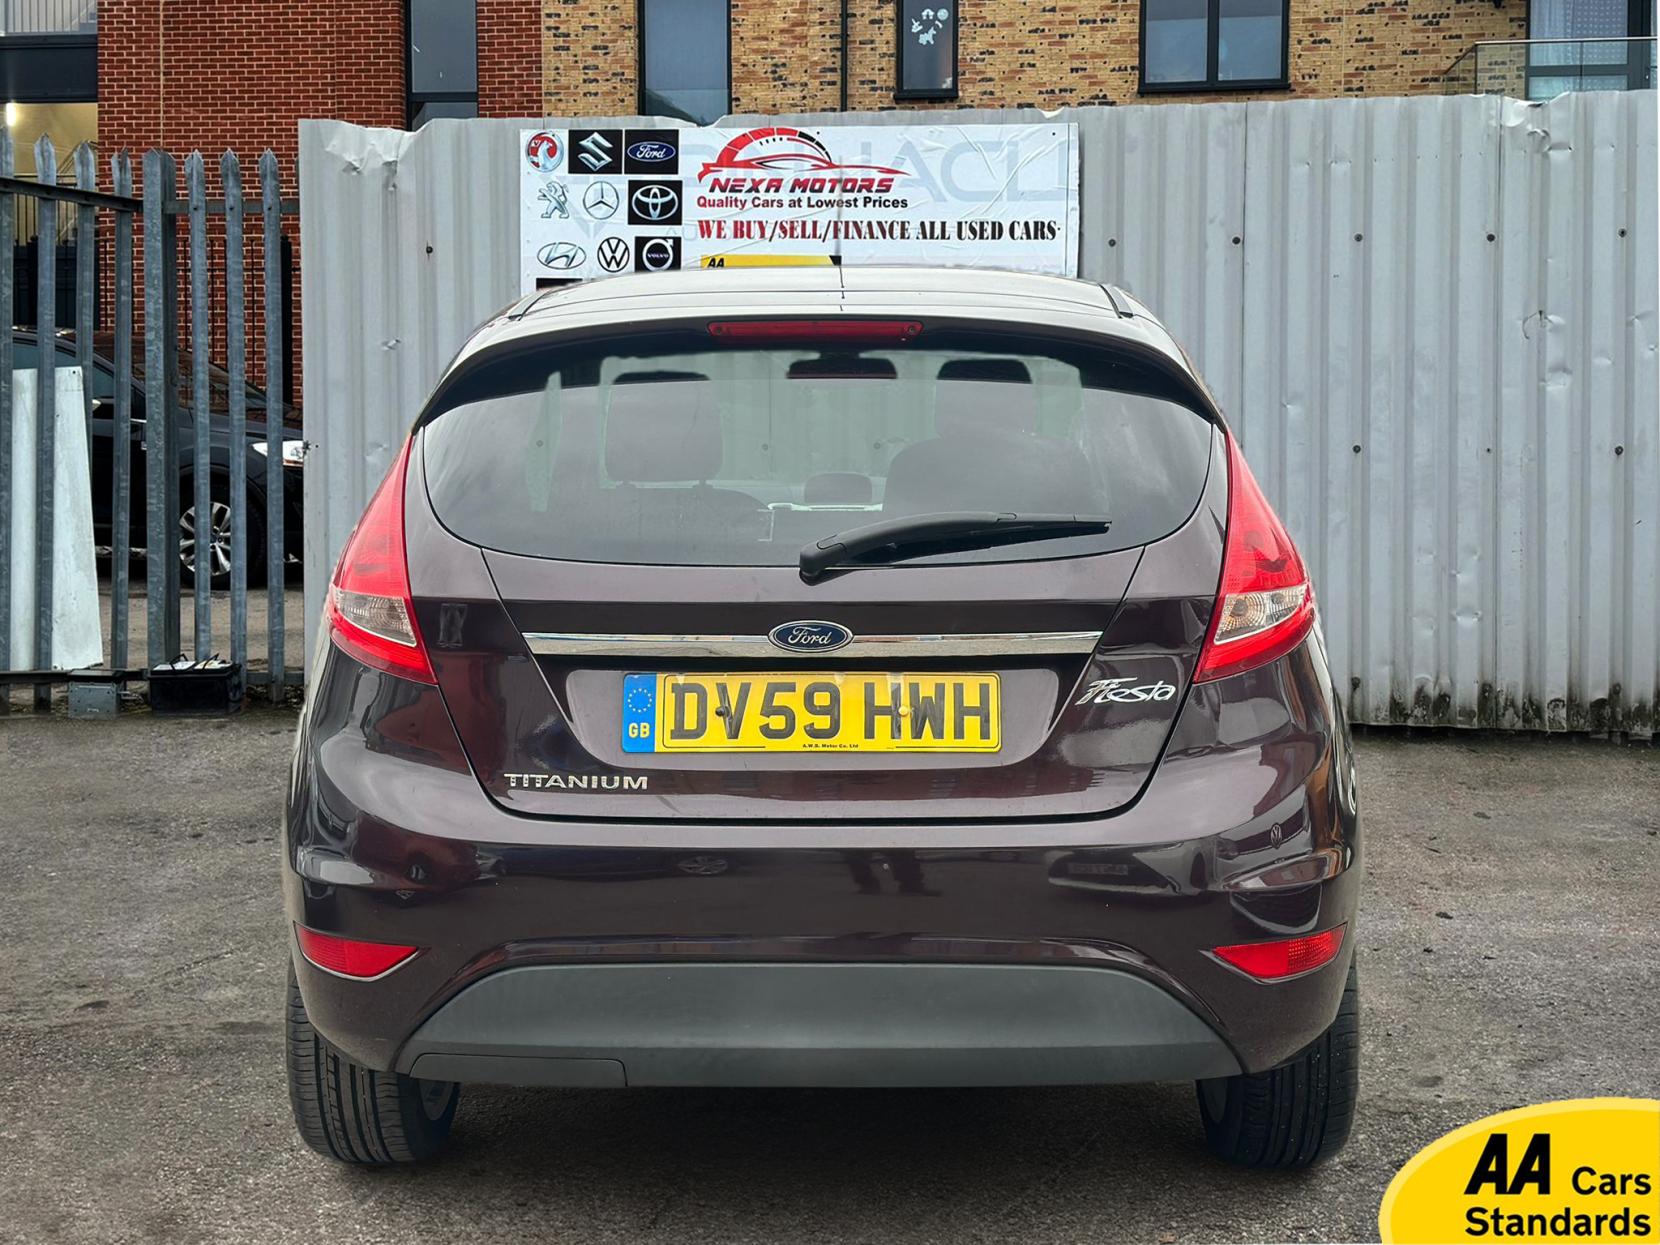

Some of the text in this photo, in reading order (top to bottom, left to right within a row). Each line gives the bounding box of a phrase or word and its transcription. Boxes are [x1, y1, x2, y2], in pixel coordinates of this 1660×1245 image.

[636, 144, 666, 158] Ford
[709, 178, 894, 193] NEXA MOTORS
[697, 196, 908, 210] Quality Cars at Lowest Prices
[698, 220, 727, 239] WE
[916, 220, 950, 240] ALL
[957, 220, 1004, 240] USED
[788, 626, 832, 644] Ford
[1075, 677, 1176, 705] Fiesta
[670, 682, 991, 740] DV59 HWH
[628, 722, 650, 738] GB
[504, 773, 648, 790] TITANIUM
